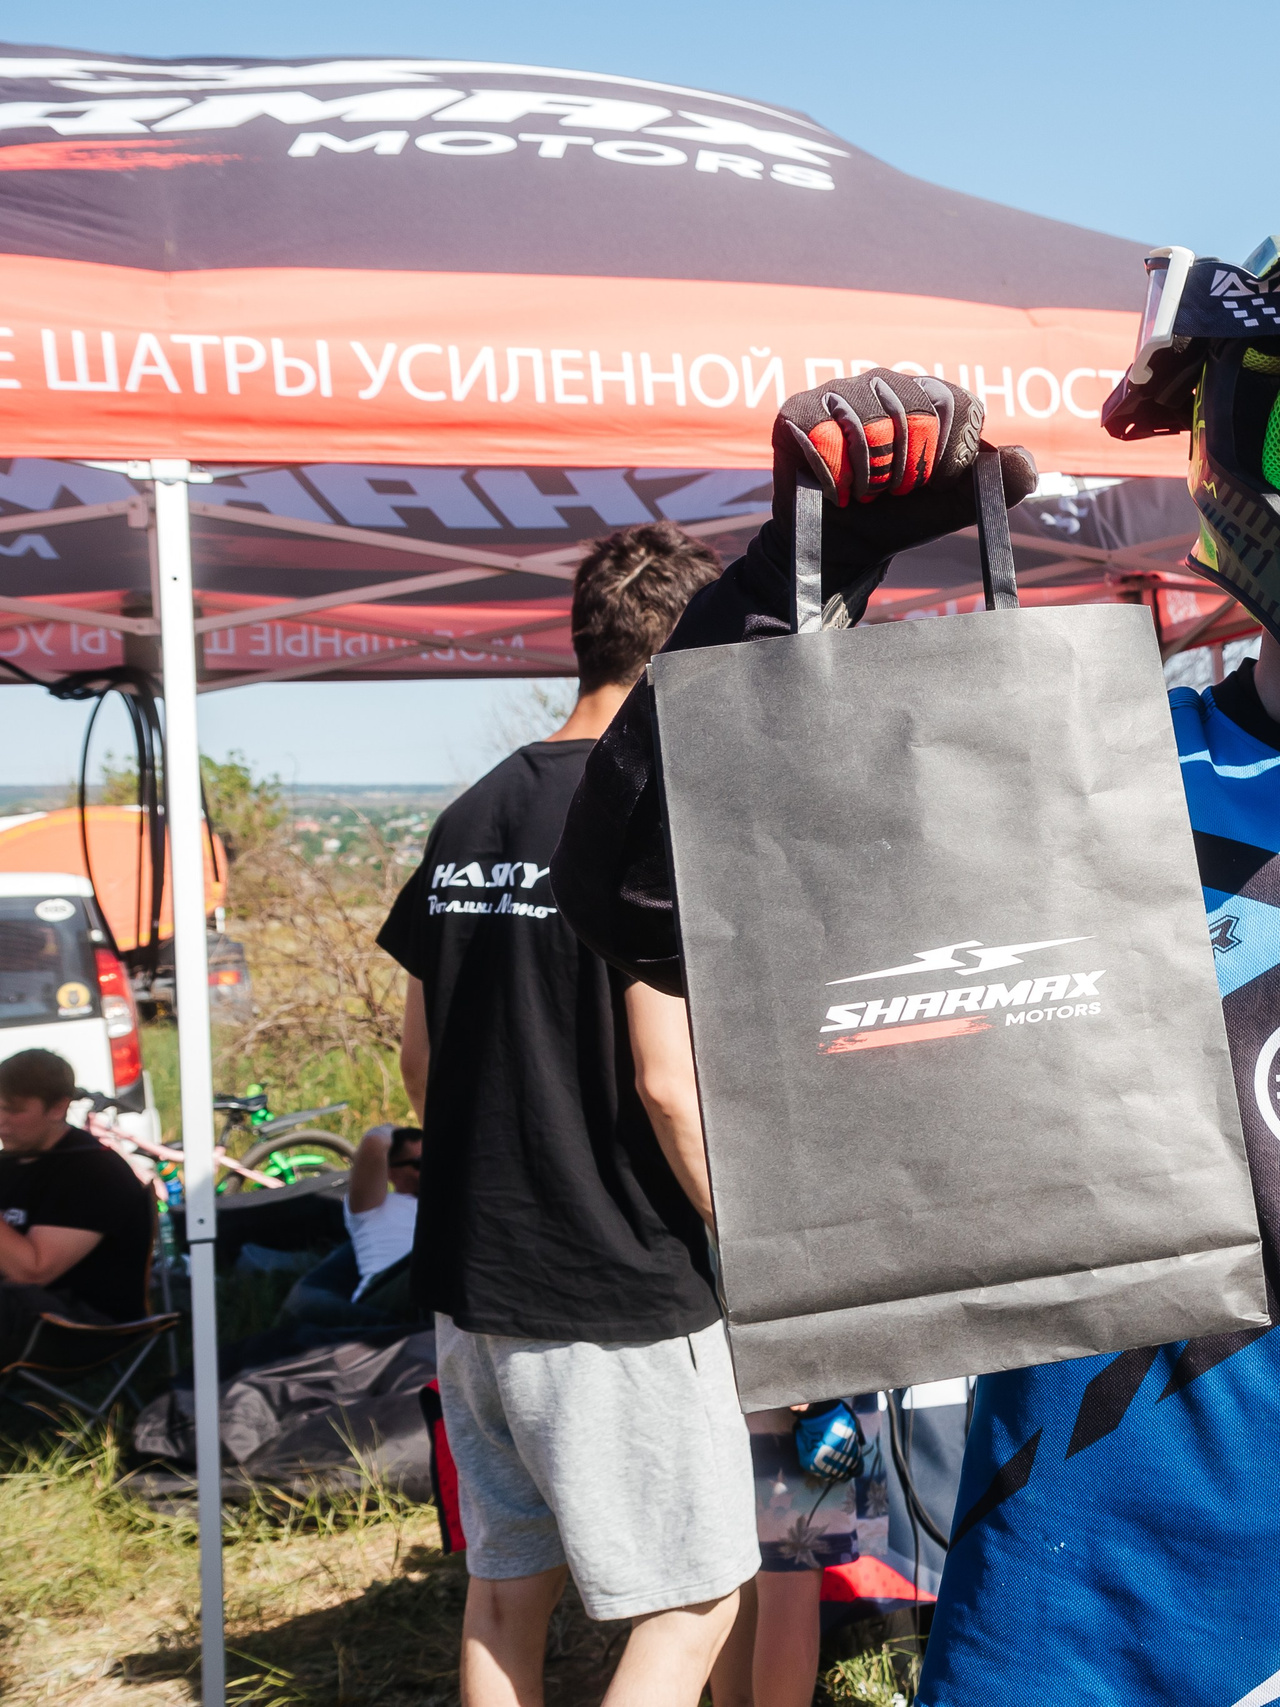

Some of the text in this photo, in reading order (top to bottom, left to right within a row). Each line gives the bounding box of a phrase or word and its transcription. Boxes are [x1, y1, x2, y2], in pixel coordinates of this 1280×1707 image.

[287, 130, 836, 191] MOTORS
[40, 328, 333, 399] ШАТРЫ
[349, 339, 787, 411] УСИЛЕННОЙ
[819, 970, 1107, 1033] SHARMAX
[1004, 1001, 1102, 1027] MOTORS
